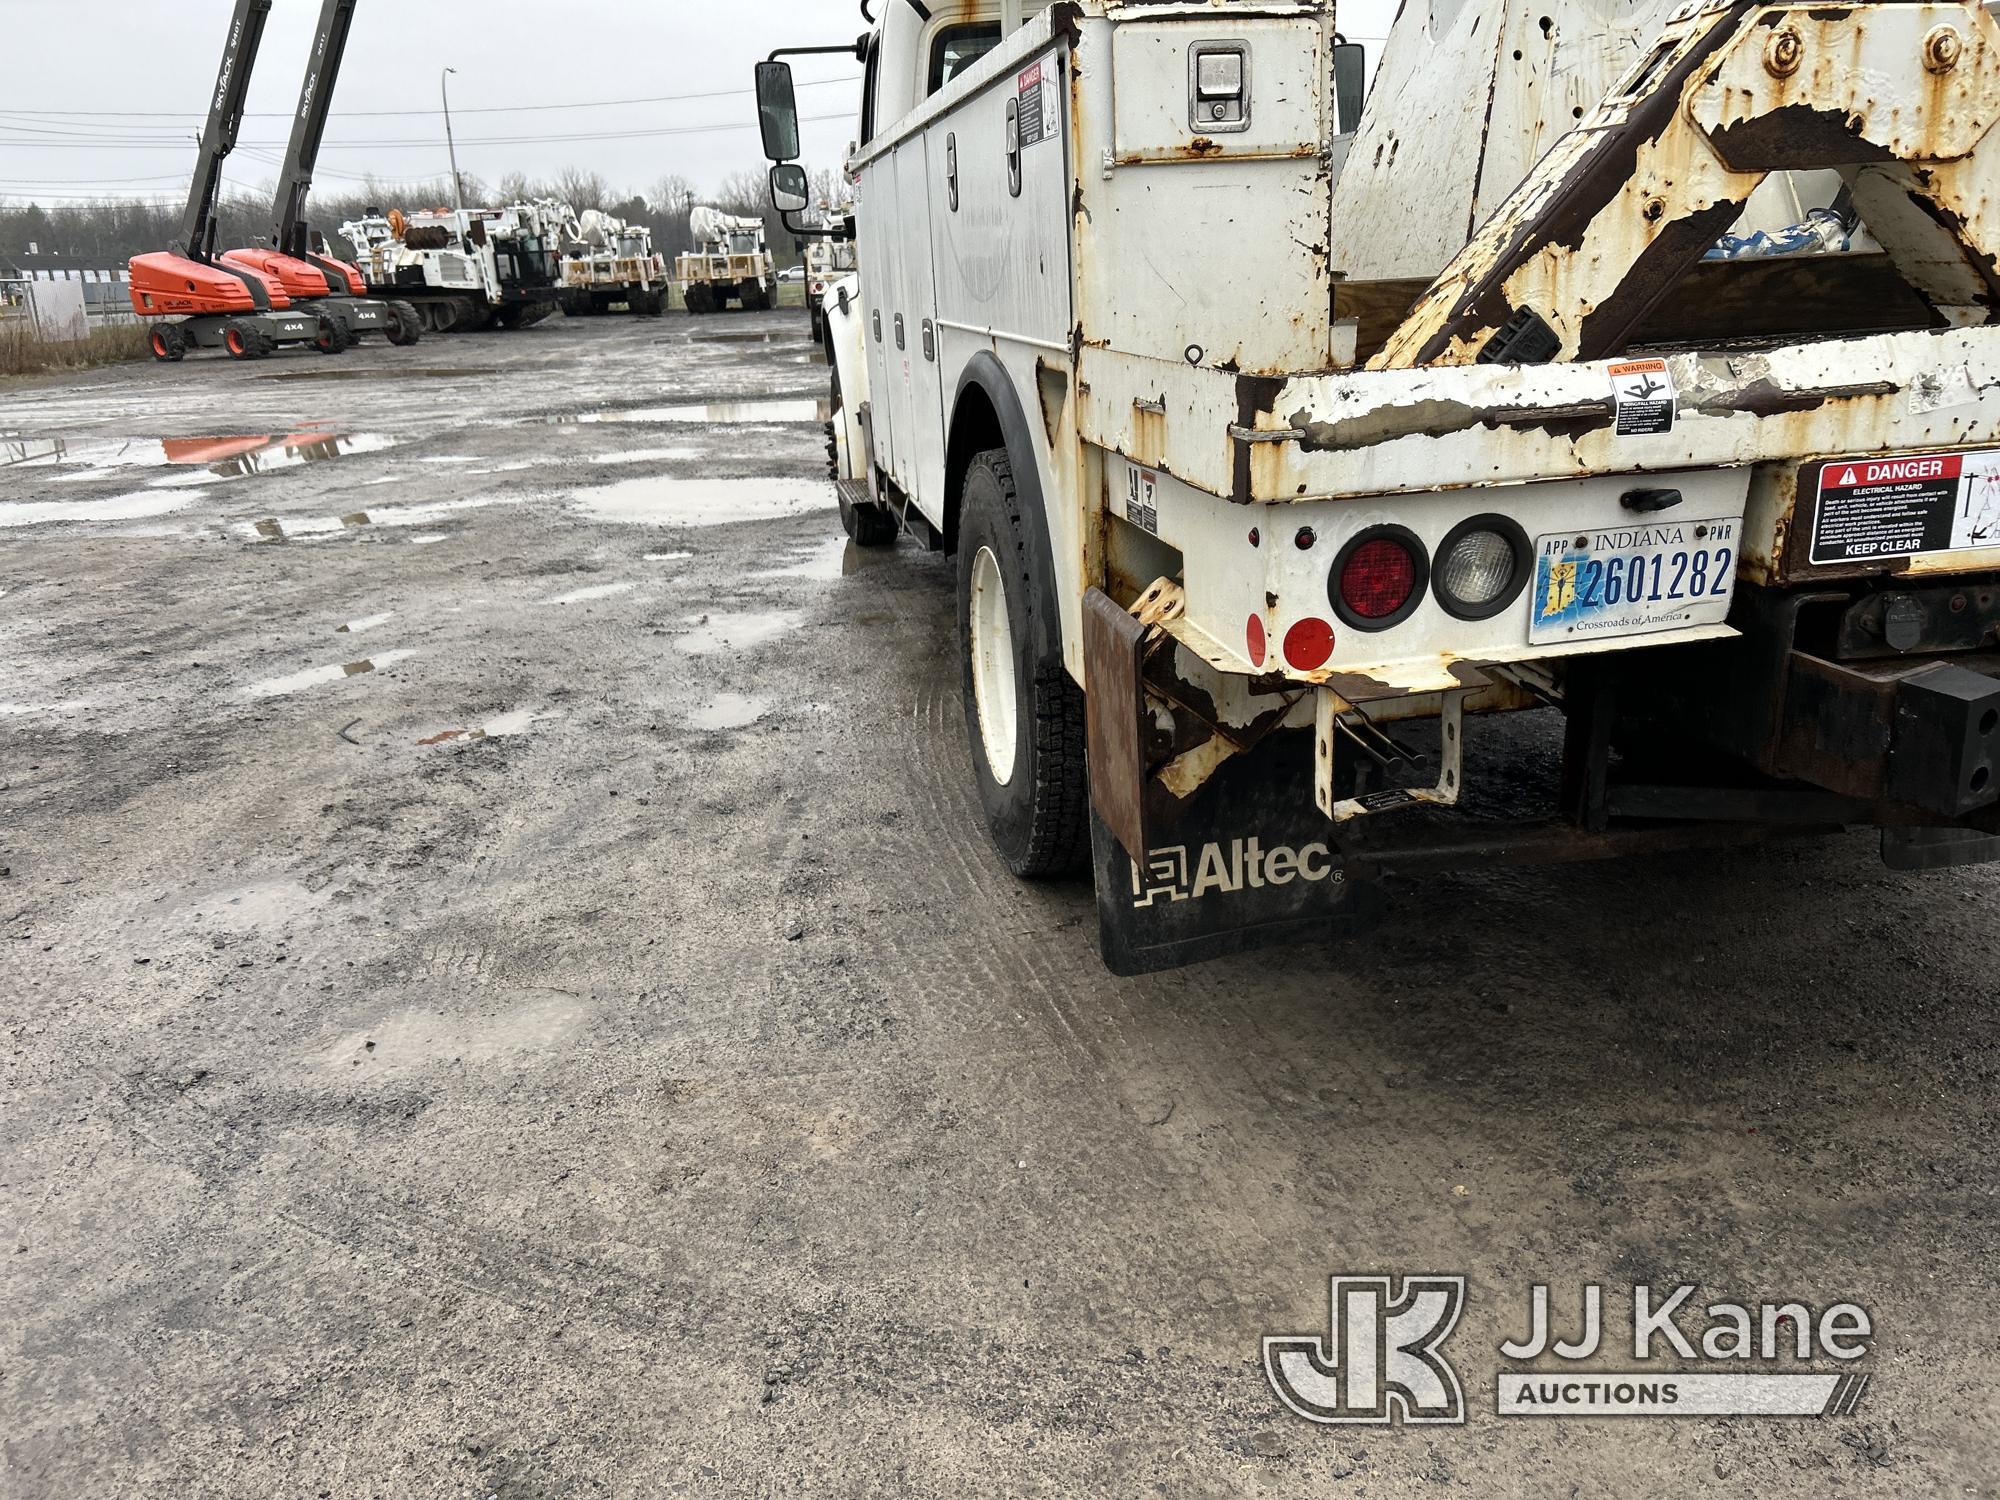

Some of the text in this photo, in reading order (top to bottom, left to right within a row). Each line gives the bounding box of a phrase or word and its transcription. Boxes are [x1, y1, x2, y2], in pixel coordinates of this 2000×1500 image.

[215, 56, 232, 110] SKYJACK
[302, 72, 316, 118] SKYJACK
[1622, 362, 1662, 372] WARNING
[1866, 460, 1943, 481] DANGER
[1853, 486, 1893, 495] ELECTRICAL
[1545, 524, 1731, 555] APP INDIANA PWR
[1845, 538, 1920, 555] KEEP CLEAR
[1582, 548, 1732, 608] 2601282
[1576, 613, 1682, 631] Crossroads of America
[1192, 836, 1332, 898] Altec
